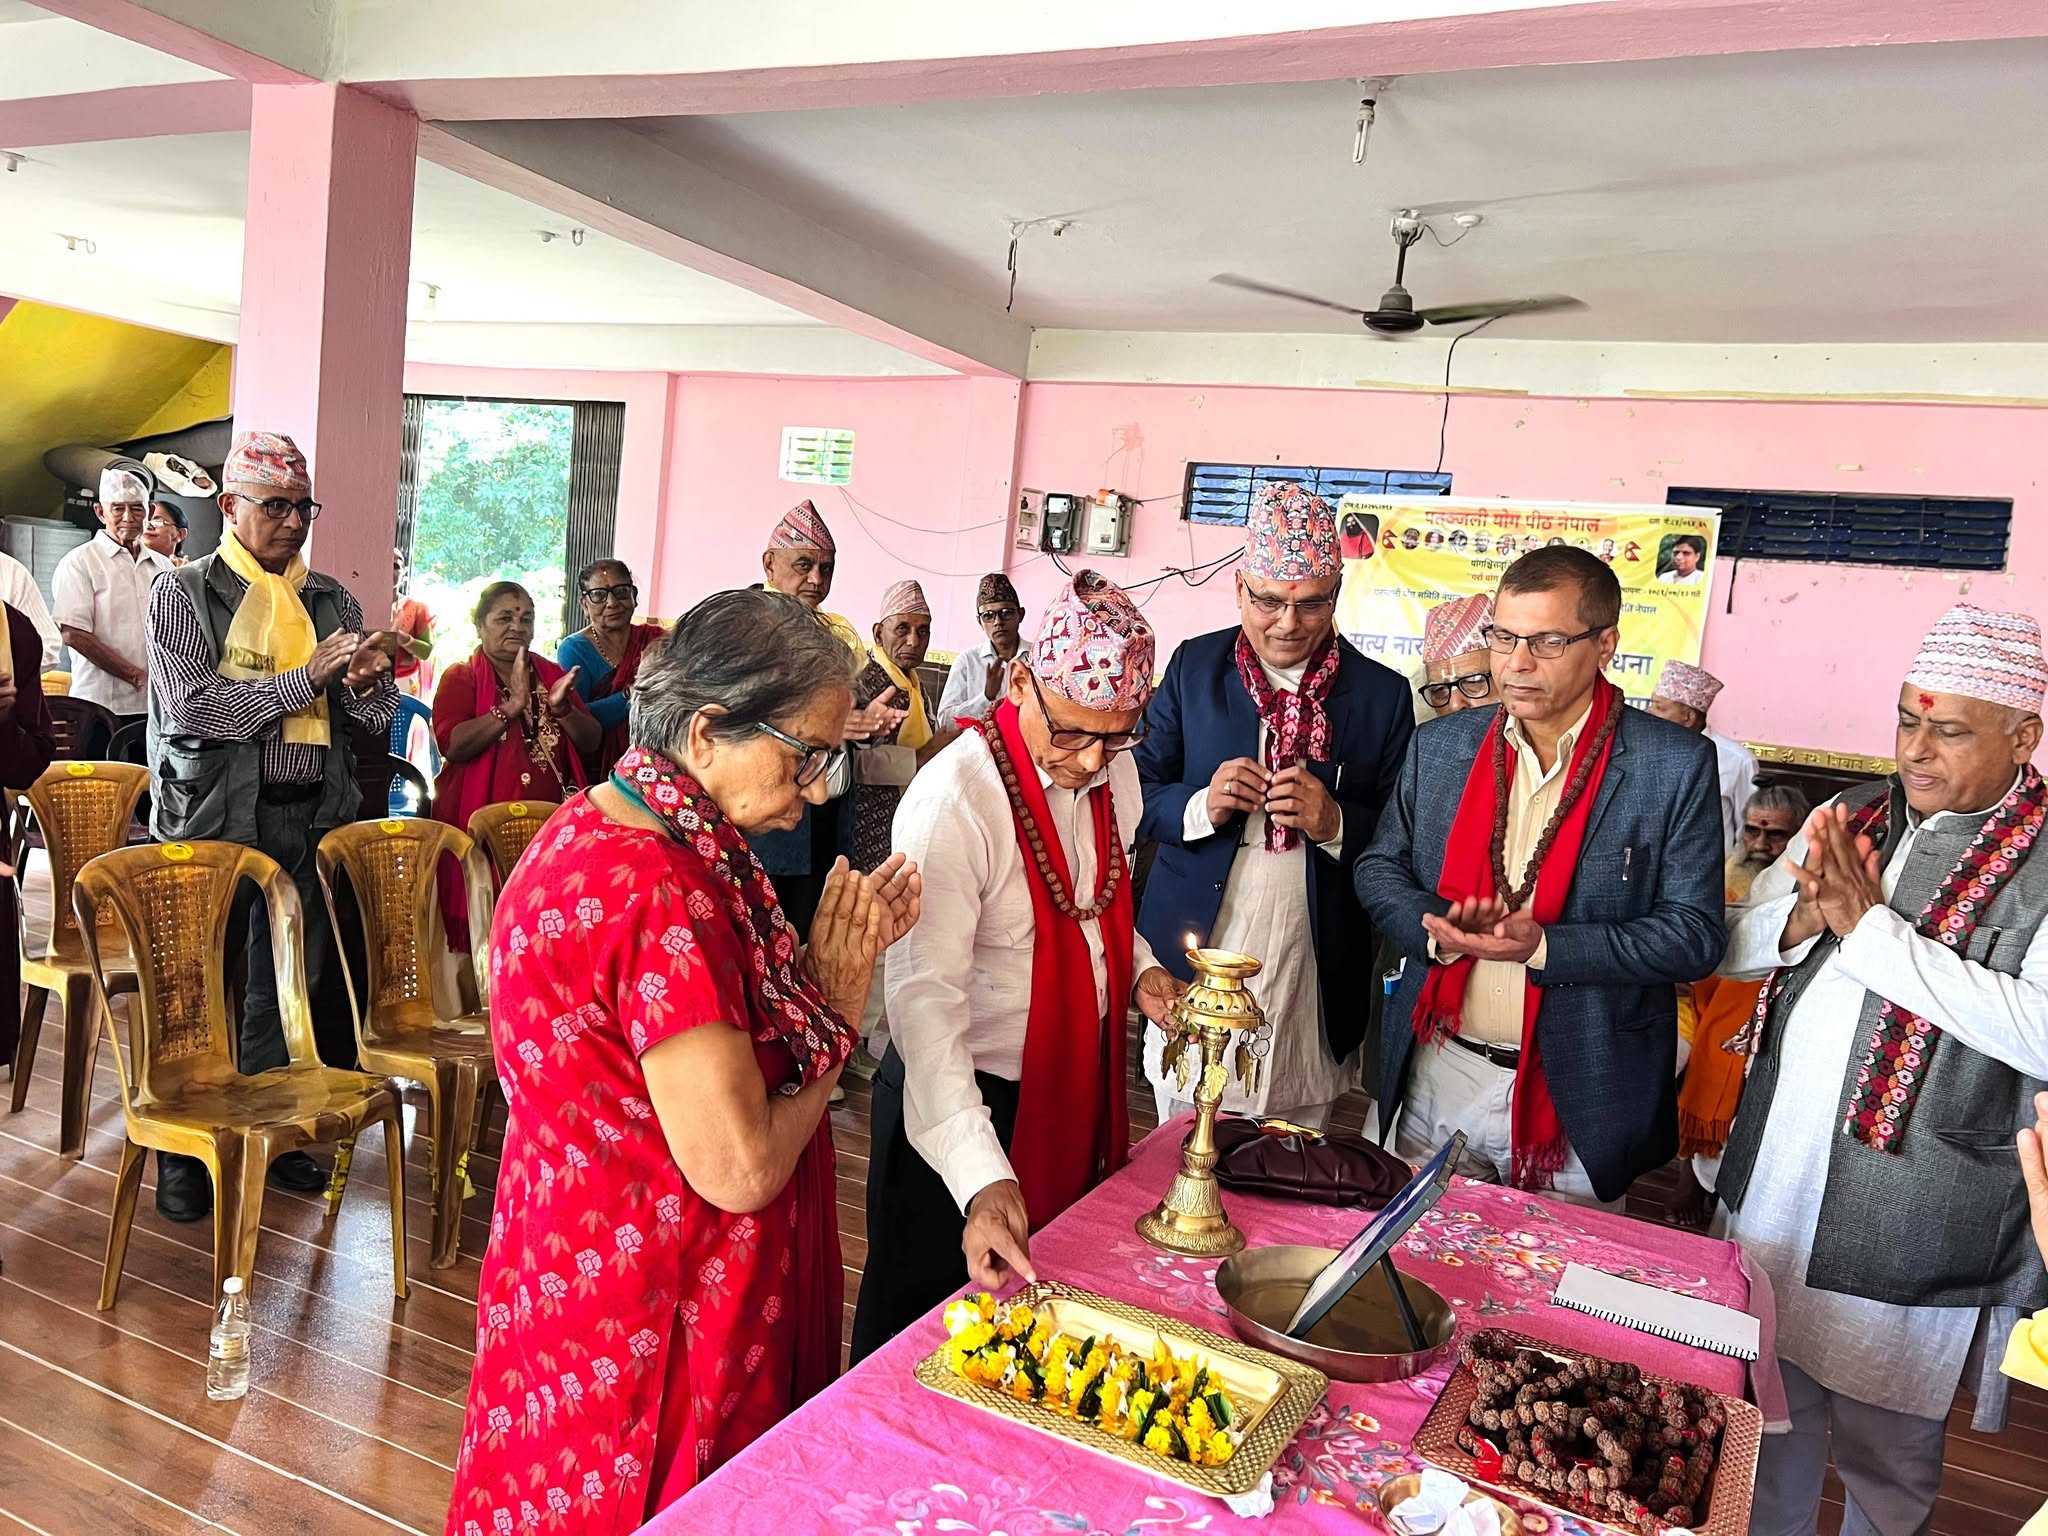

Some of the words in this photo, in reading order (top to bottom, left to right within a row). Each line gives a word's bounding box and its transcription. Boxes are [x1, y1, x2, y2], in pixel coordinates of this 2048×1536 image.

[1493, 507, 1521, 529] योग
[1525, 509, 1552, 531] पीठ
[1557, 511, 1600, 533] नेपाल
[1418, 589, 1440, 600] समिति
